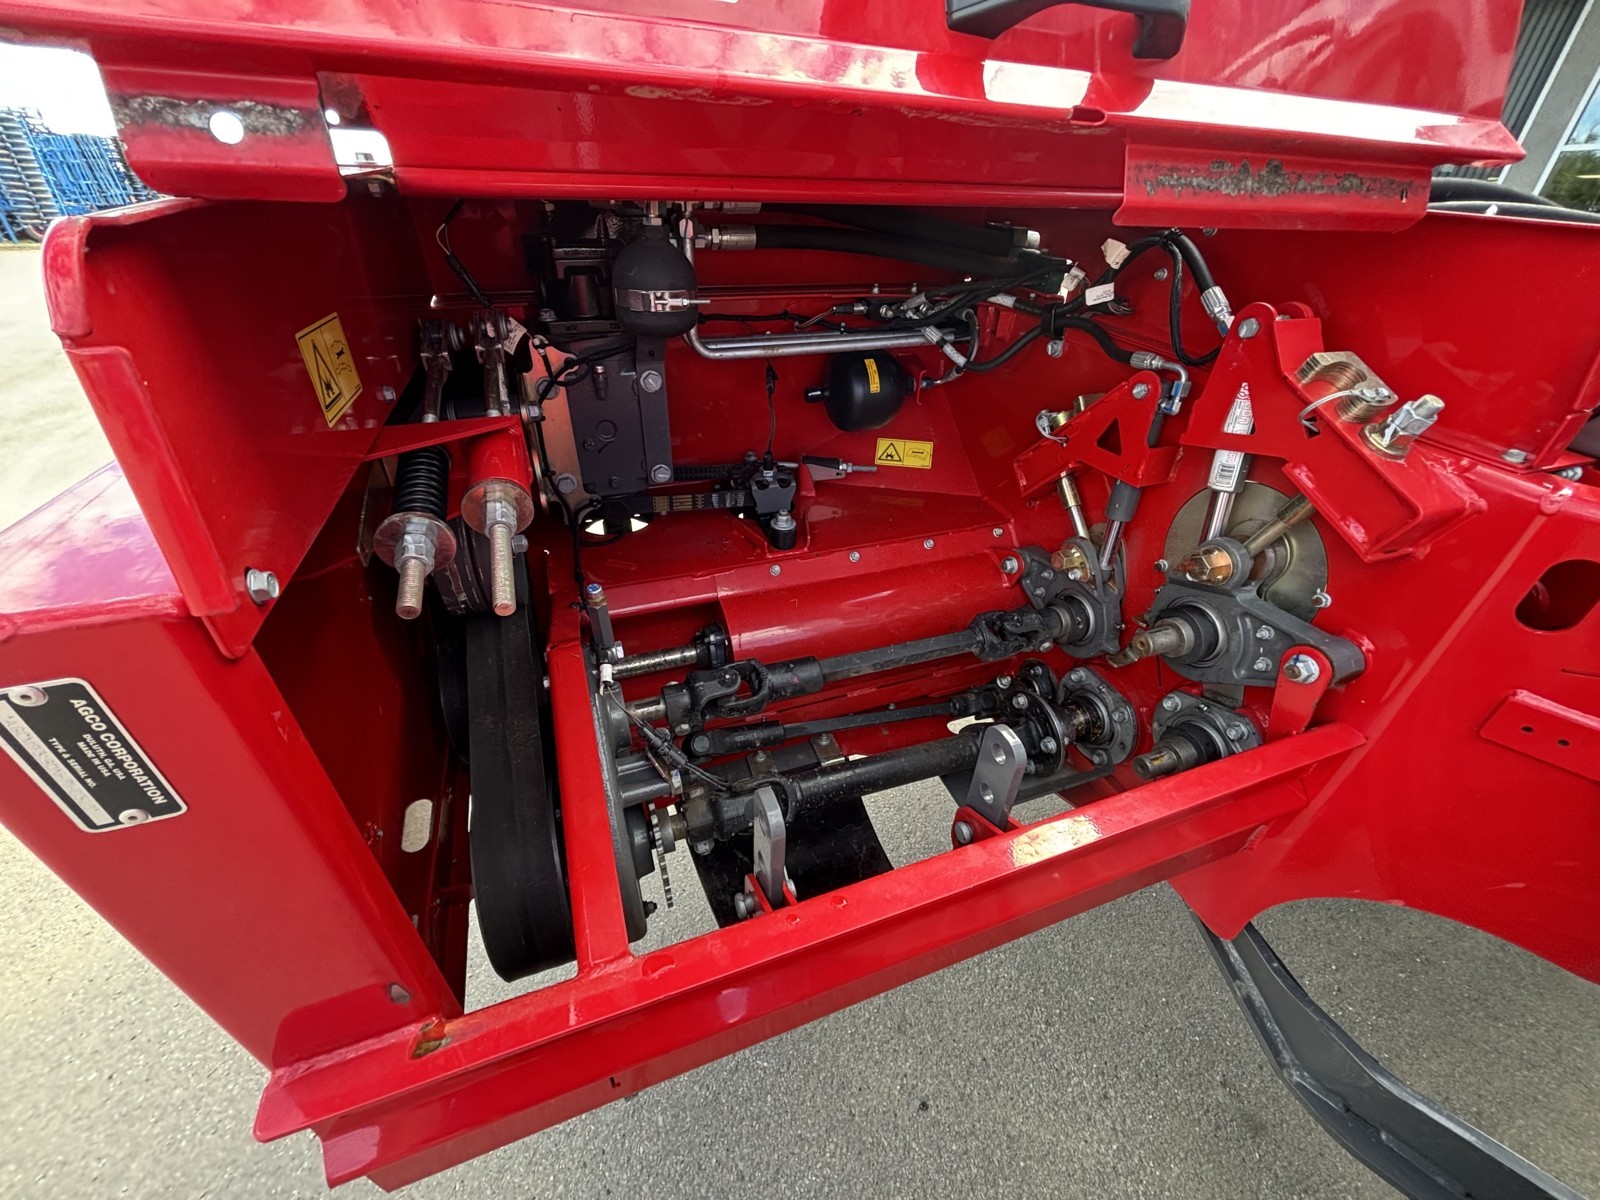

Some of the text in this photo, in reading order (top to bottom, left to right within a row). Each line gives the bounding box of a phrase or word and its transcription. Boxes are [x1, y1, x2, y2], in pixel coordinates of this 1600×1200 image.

[48, 737, 66, 754] TYPE
[67, 758, 89, 779] SERIAL
[84, 778, 97, 789] NO.
[69, 699, 168, 805] AGCO CORPORATION
[76, 741, 112, 777] MADE IN USA
[112, 768, 126, 780] USA
